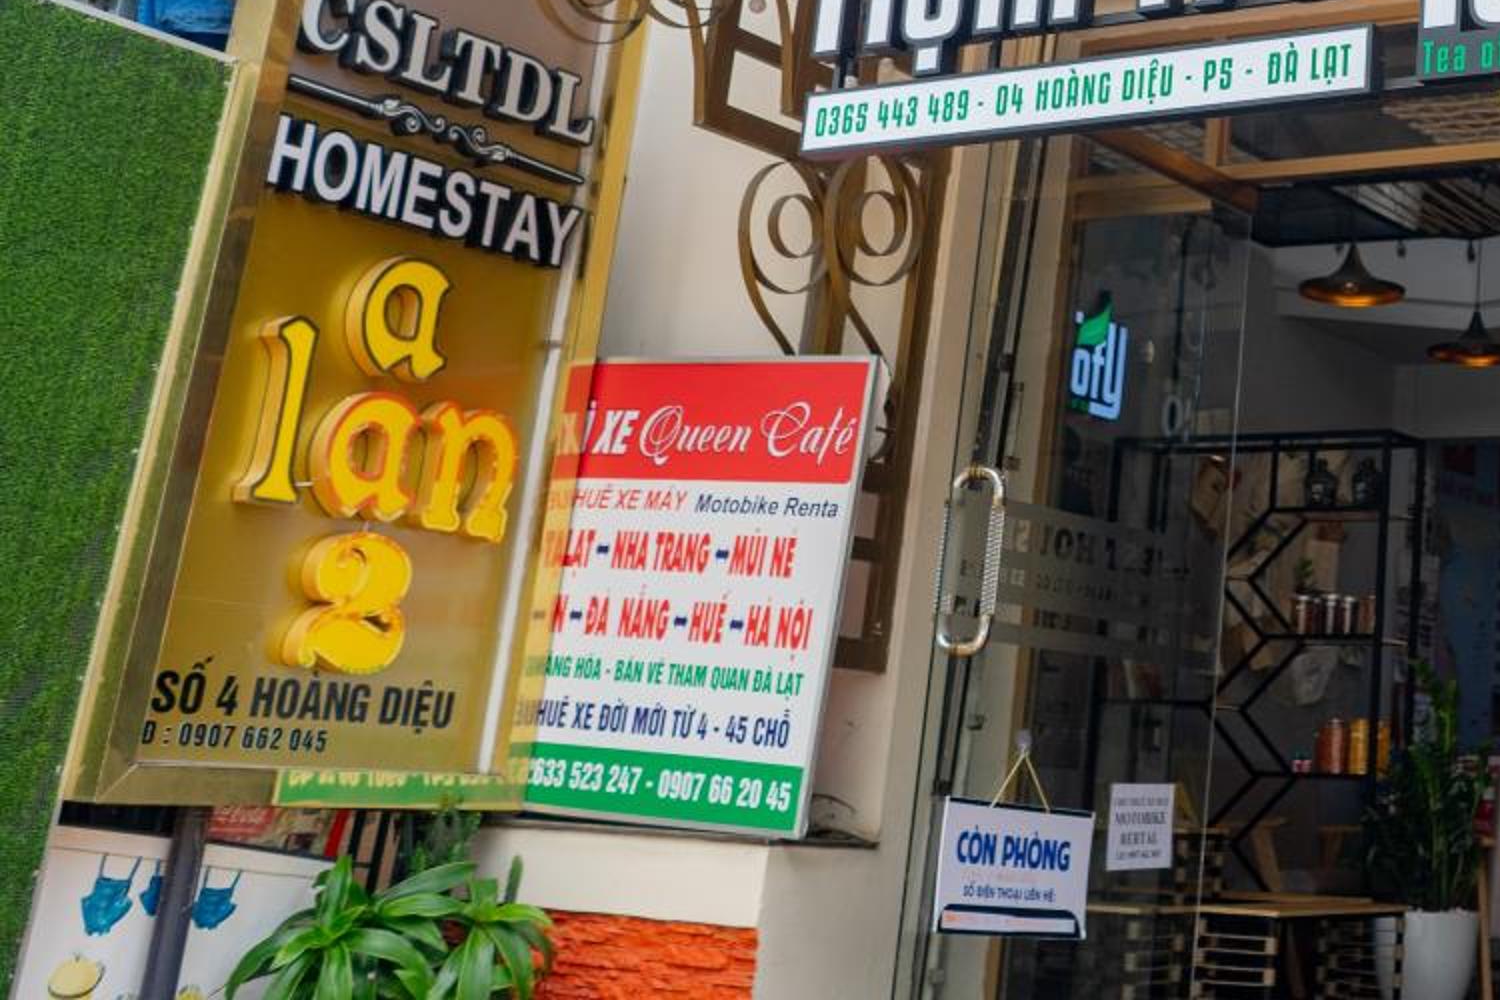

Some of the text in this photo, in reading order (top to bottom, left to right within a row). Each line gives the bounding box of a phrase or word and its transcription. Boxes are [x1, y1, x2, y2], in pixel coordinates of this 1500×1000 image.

[1423, 40, 1465, 74] Tea
[816, 104, 868, 137] 0365
[878, 97, 918, 128] 443
[928, 90, 970, 123] 489
[996, 85, 1023, 115] 04
[1036, 68, 1111, 112] HOÀNG
[1122, 60, 1174, 103] DIỆU
[1267, 42, 1299, 85] ĐÀ
[1311, 43, 1352, 86] LẠT
[267, 112, 582, 267] HOMESTAY
[592, 408, 640, 455] XE
[639, 404, 752, 465] Queen
[761, 401, 857, 464] Café
[615, 489, 641, 511] XE
[694, 494, 779, 516] Motobike
[783, 498, 840, 518] Renta
[611, 530, 650, 570] NHA
[653, 531, 712, 574] TRANG
[151, 656, 456, 733] SỐ 4 HOÀNG DIỆU
[669, 663, 705, 689] THAM
[711, 666, 751, 692] QUAN
[179, 723, 328, 753] 0907 662 045
[571, 702, 595, 730] XE
[697, 713, 708, 740] 4
[725, 714, 748, 744] 45
[568, 762, 793, 812] 523 247 0907 66 20 45
[956, 824, 1071, 872] CÒN PHÒNG
